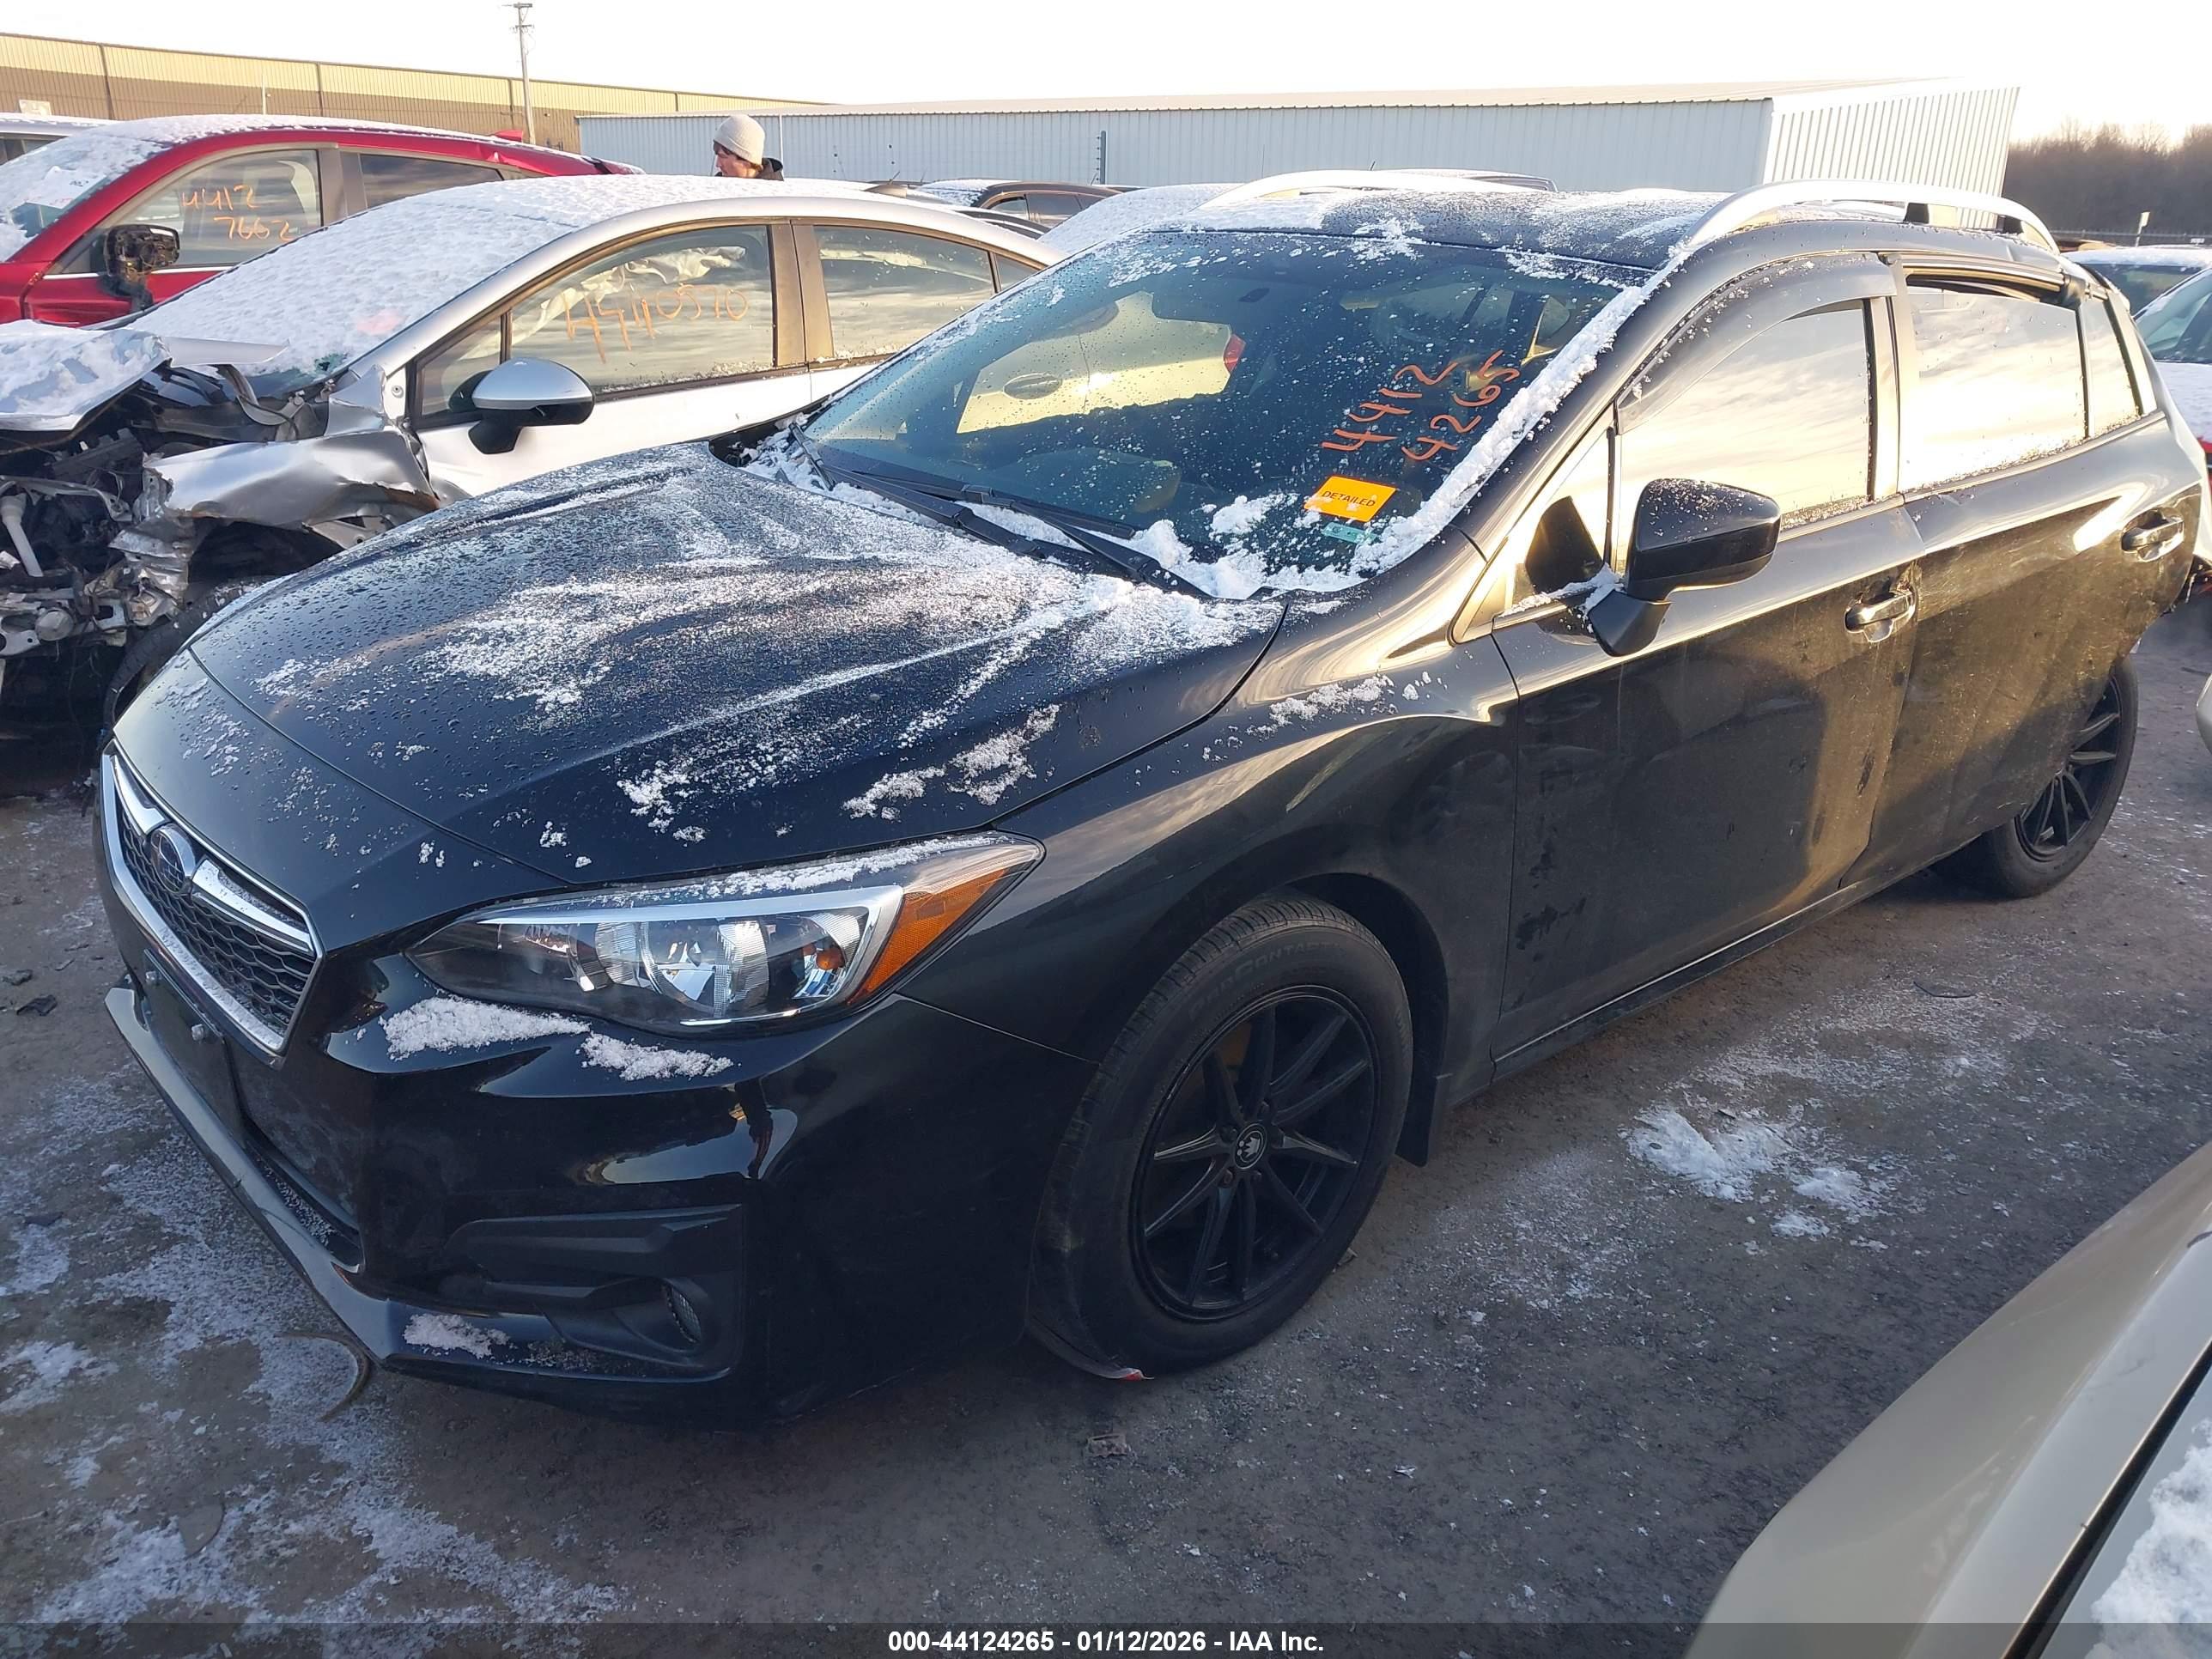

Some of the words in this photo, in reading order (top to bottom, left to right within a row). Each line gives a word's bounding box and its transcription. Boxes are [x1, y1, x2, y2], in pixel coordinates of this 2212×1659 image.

[182, 184, 261, 211] 4412
[213, 215, 296, 241] 7662
[1321, 361, 1459, 452] 4412
[1401, 349, 1521, 461] 4265
[1321, 489, 1376, 507] DETAILED
